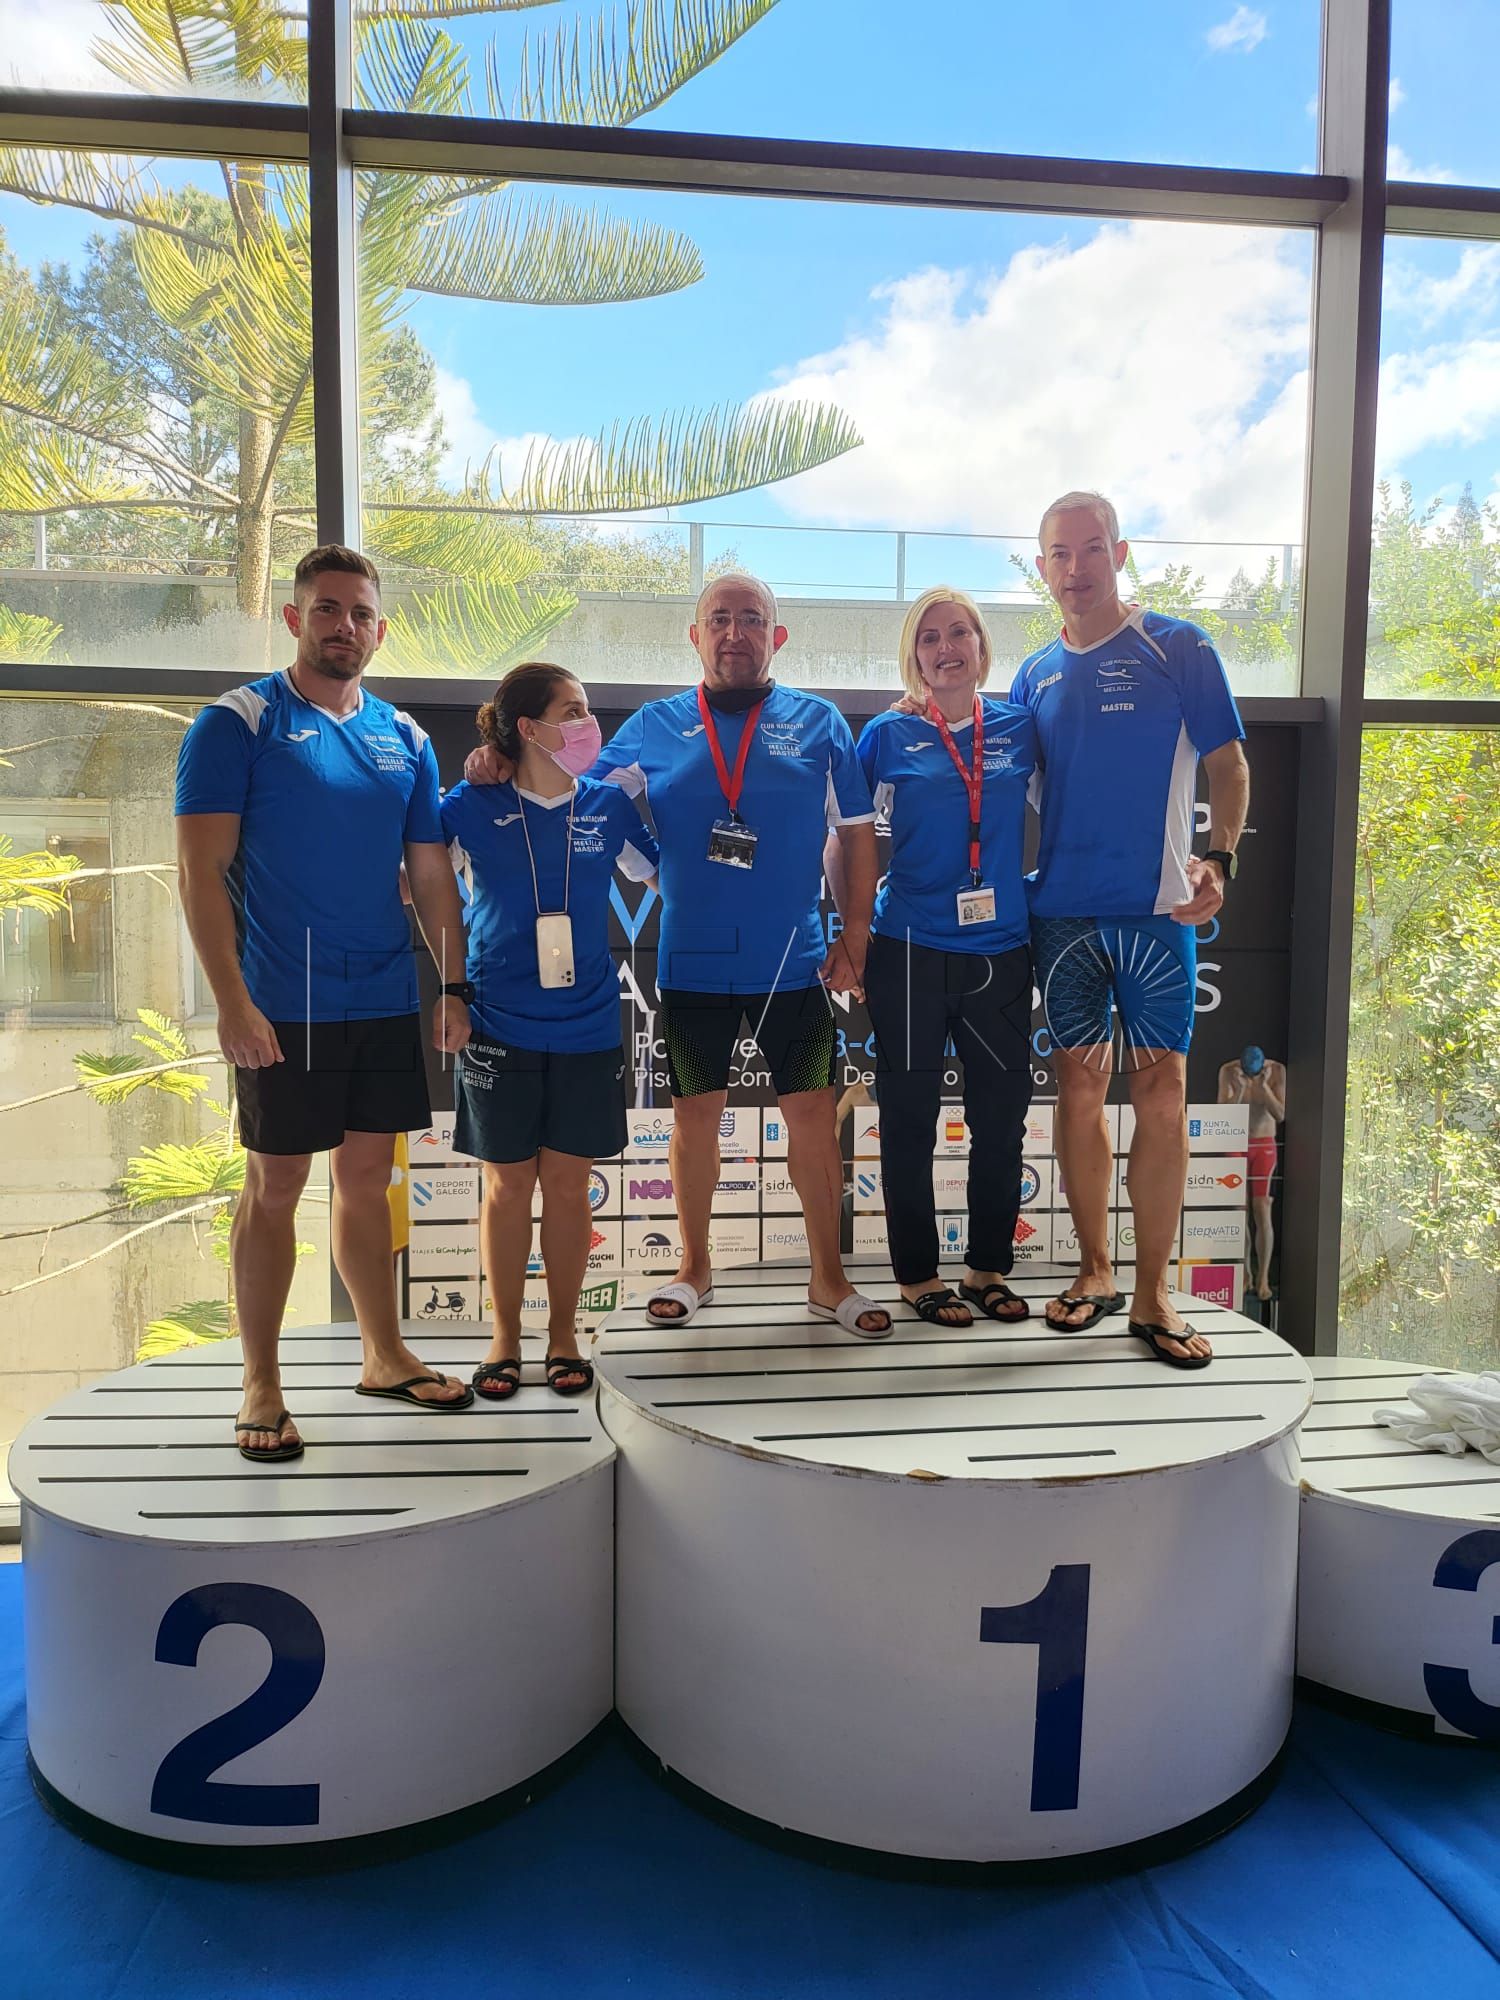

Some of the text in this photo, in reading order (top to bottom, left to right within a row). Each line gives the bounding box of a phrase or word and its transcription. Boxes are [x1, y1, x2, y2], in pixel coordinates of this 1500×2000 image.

[1100, 703, 1135, 713] MASTER
[768, 744, 800, 752] MELILLA
[769, 750, 802, 758] MASTER
[1203, 1120, 1230, 1128] XUNTA
[1202, 1128, 1247, 1136] DE GALICIA
[435, 1180, 475, 1188] DEPORTE
[1187, 1174, 1214, 1186] sidn
[766, 1179, 794, 1191] sidn
[435, 1188, 471, 1196] GALEGO
[980, 1564, 1091, 1811] 1
[150, 1582, 326, 1825] 2
